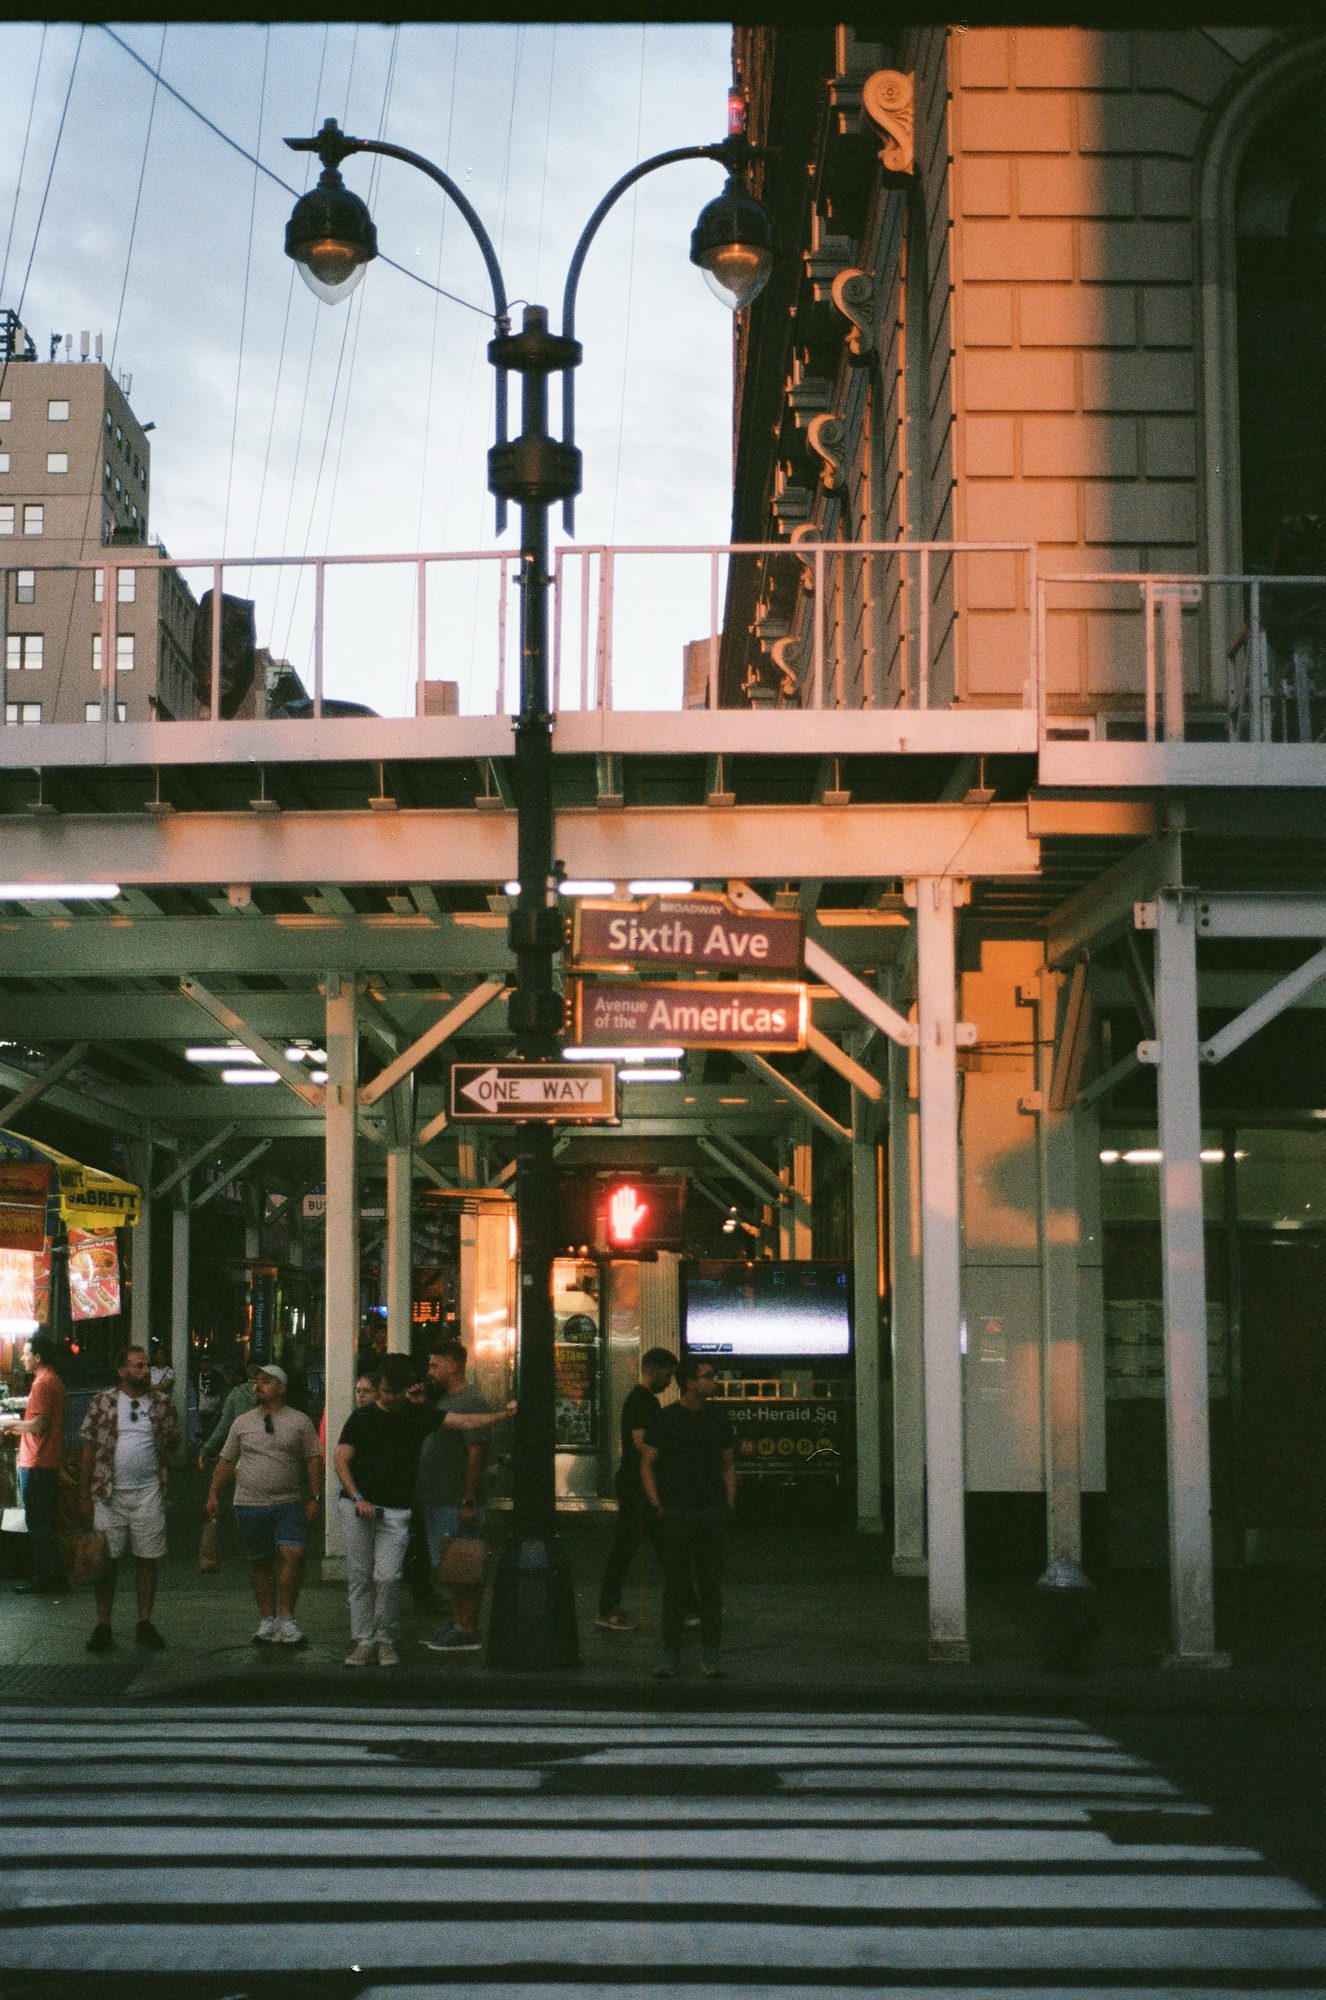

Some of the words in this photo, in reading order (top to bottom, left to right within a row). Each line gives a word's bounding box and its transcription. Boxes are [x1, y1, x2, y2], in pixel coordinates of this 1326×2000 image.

[660, 902, 722, 914] BROADWAY
[609, 918, 694, 955] Sixth
[703, 924, 769, 958] Ave
[594, 997, 648, 1013] Avenue
[594, 1013, 610, 1029] of
[613, 1014, 637, 1029] the
[649, 999, 787, 1033] Americas
[478, 1081, 520, 1100] ONE
[543, 1081, 589, 1100] WAY
[727, 1406, 810, 1421] eet-Herald
[815, 1406, 837, 1423] Sq
